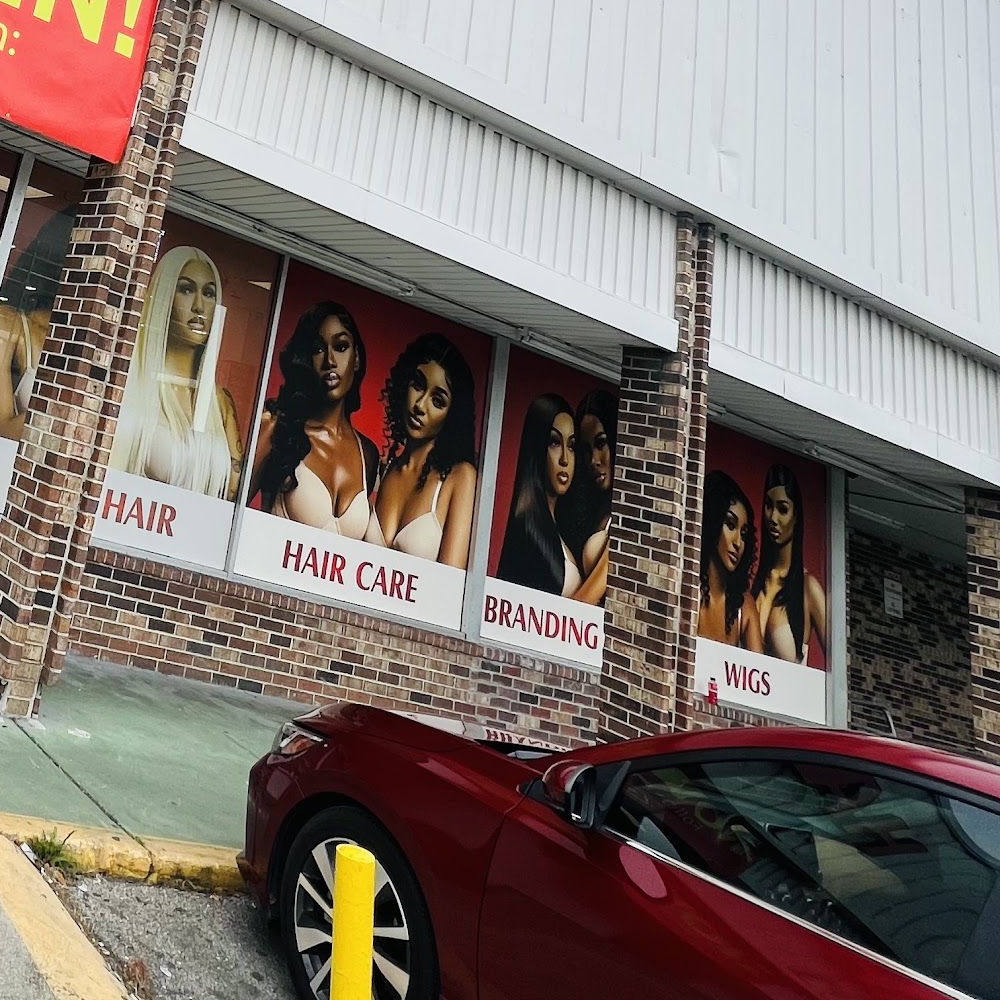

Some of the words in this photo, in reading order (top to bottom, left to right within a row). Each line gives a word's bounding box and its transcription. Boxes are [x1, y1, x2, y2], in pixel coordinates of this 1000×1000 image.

[101, 488, 178, 537] HAIR
[281, 539, 347, 585] HAIR
[355, 561, 419, 603] CARE
[483, 594, 600, 651] BRANDING
[723, 660, 772, 697] WIGS
